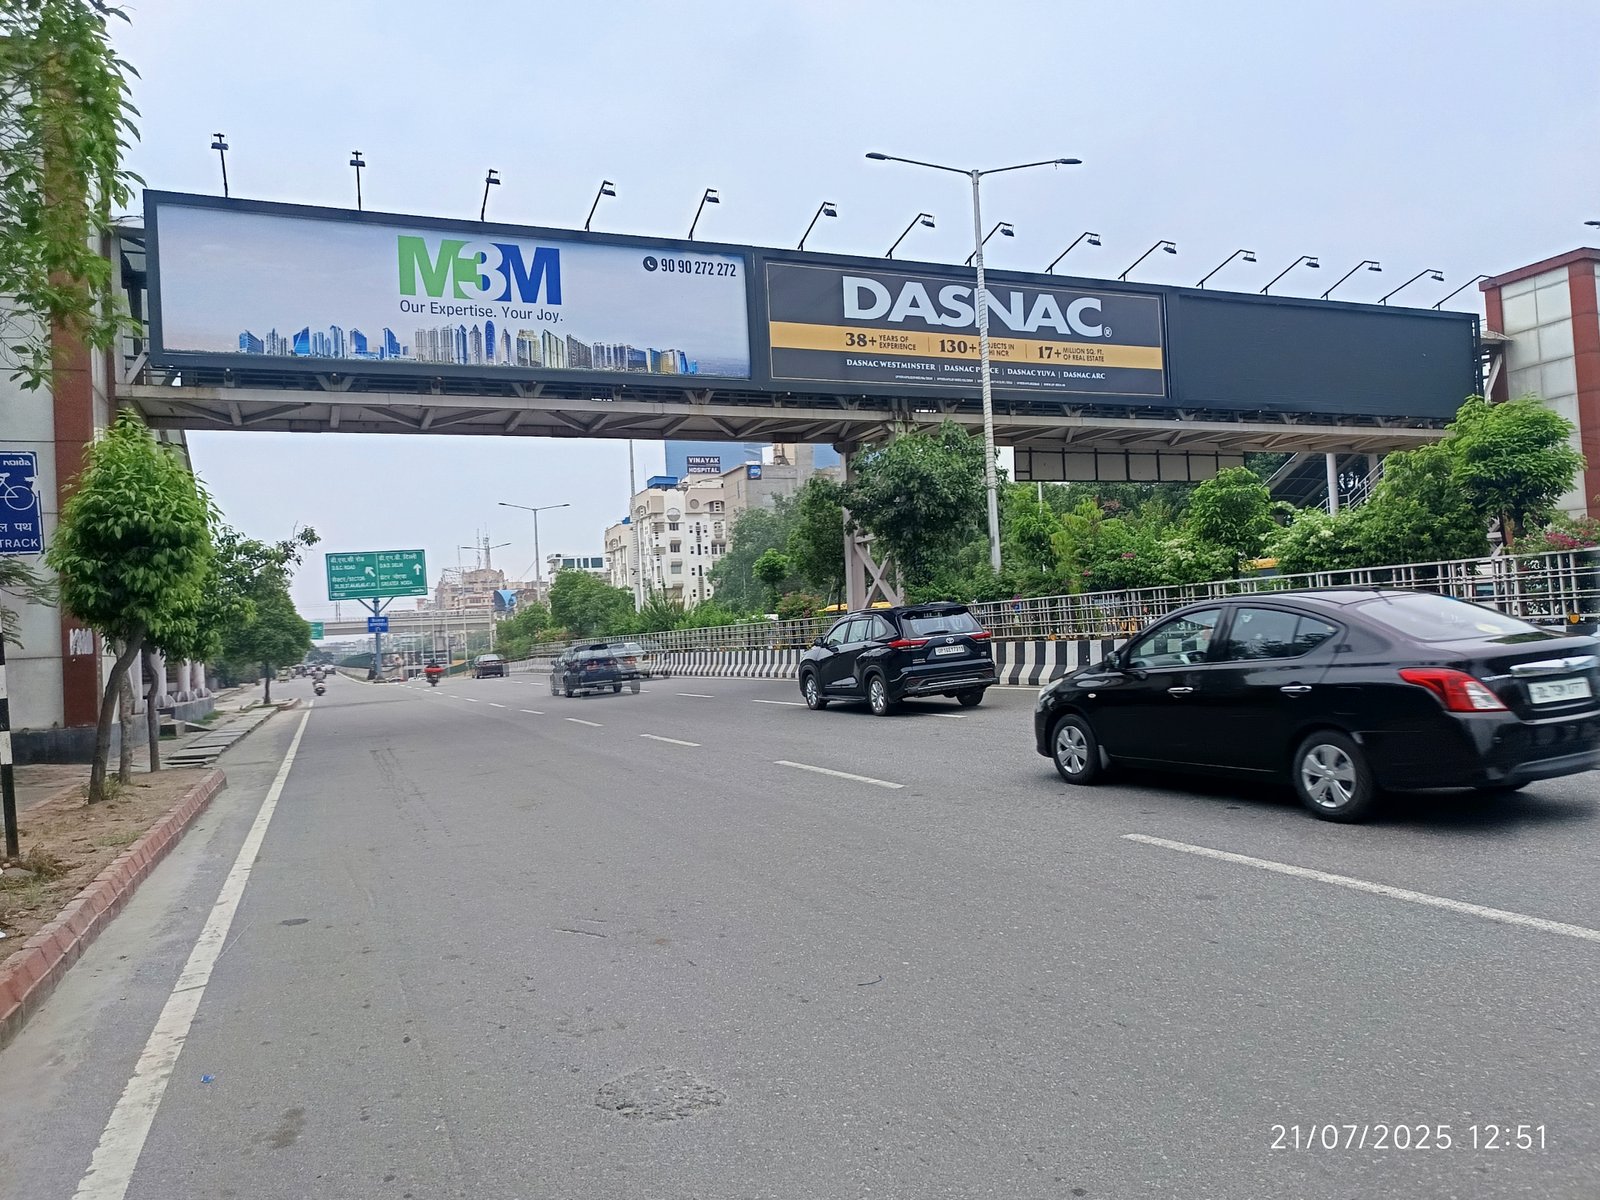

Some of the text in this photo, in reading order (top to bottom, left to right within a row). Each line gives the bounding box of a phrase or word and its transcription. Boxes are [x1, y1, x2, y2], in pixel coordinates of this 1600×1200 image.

[397, 235, 562, 305] M3M
[661, 258, 736, 277] 90 90 272 272
[400, 300, 563, 323] Our Expertise. Your Joy.
[843, 275, 1103, 337] DASNAC
[845, 332, 877, 347] 38+
[879, 334, 898, 342] YEARS
[879, 342, 917, 351] EXPERIENCE
[939, 339, 977, 354] 130+
[1038, 346, 1062, 359] 17+
[1062, 347, 1086, 355] MILLION
[846, 359, 879, 368] DASNAC
[879, 360, 936, 371] WESTMINSTER
[944, 364, 974, 373] DASNAC
[1007, 368, 1036, 376] DASNAC
[1036, 369, 1056, 377] YUVA
[1063, 371, 1091, 379] DASNAC
[1091, 372, 1106, 380] ARC
[14, 522, 33, 532] पथ
